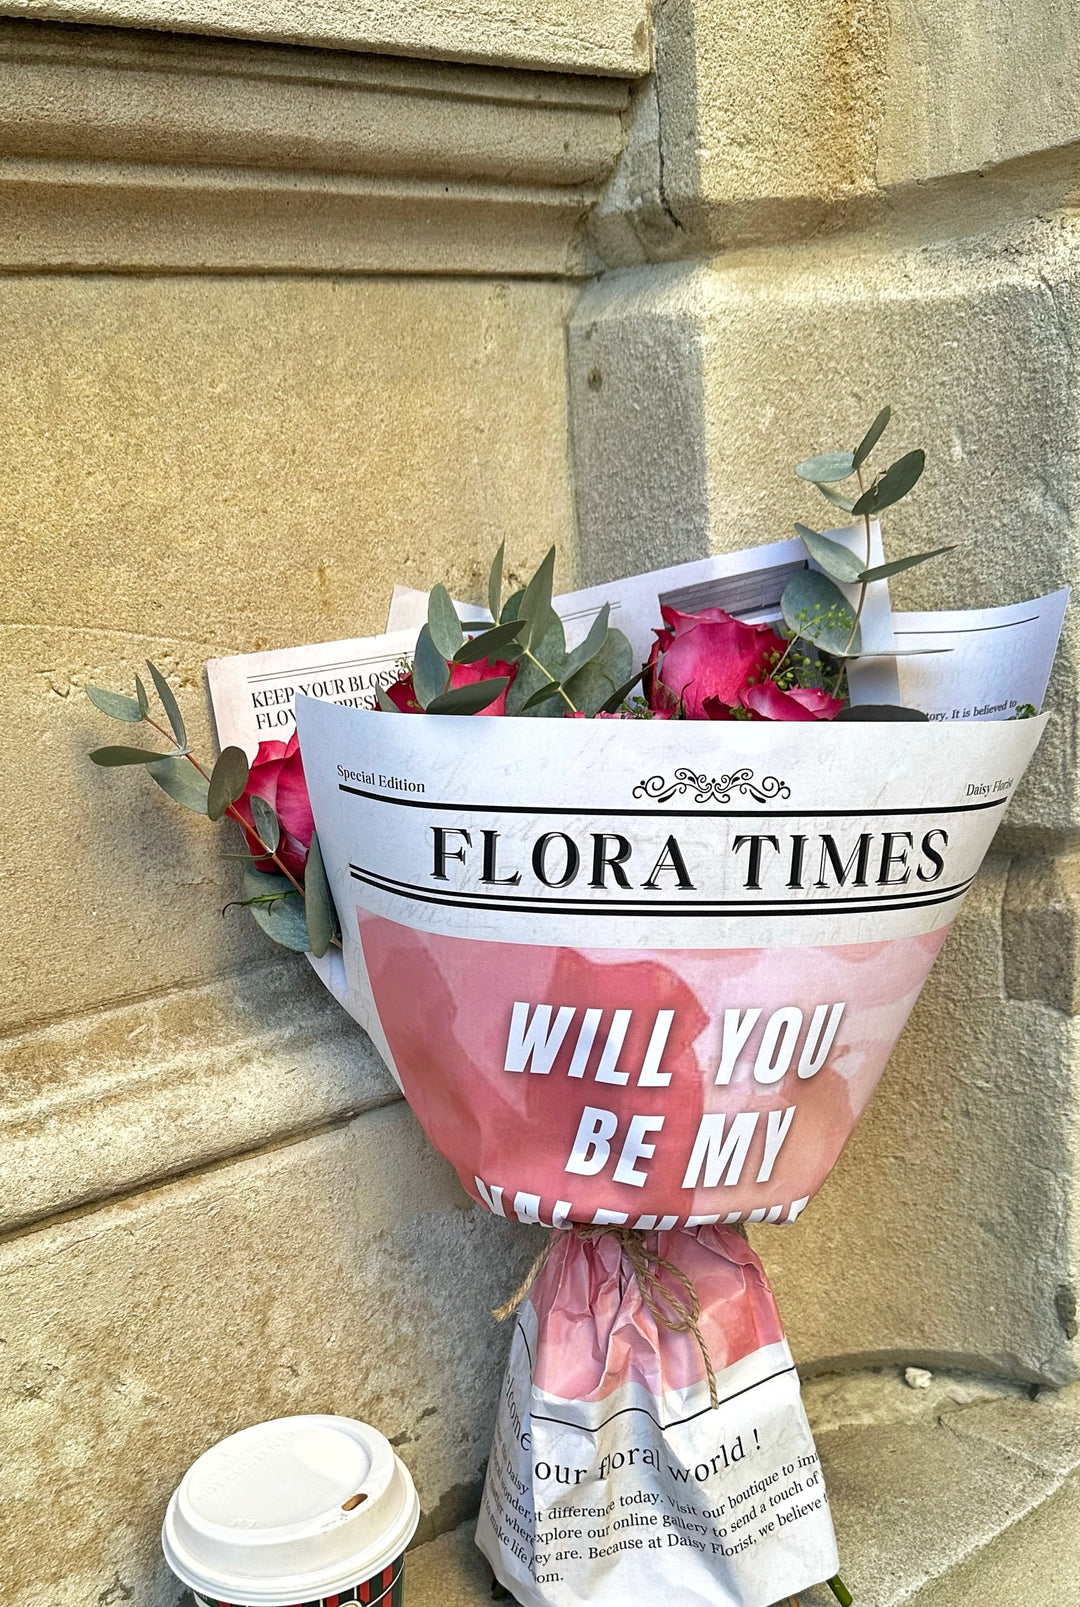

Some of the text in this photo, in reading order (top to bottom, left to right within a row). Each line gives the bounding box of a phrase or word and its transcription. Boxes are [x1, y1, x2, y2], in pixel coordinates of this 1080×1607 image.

[251, 687, 294, 708] KEEP
[298, 677, 346, 699] YOUR
[926, 699, 1018, 722] tory. It is believed to
[337, 764, 426, 793] Special Edition
[966, 783, 990, 797] Daisy
[429, 826, 949, 891] FLORA TIMES
[504, 1001, 846, 1087] WILL YOU
[564, 1105, 796, 1189] BE MY
[506, 1461, 530, 1496] Daisy
[534, 1461, 587, 1485] our
[598, 1447, 661, 1480] floral
[667, 1435, 746, 1484] world
[501, 1478, 533, 1523] wonder,
[548, 1500, 615, 1520] difference
[619, 1490, 663, 1507] today.
[666, 1494, 698, 1516] Visit
[702, 1504, 725, 1518] our
[727, 1472, 780, 1509] boutique
[782, 1463, 795, 1476] to
[587, 1525, 610, 1539] our
[613, 1512, 658, 1531] online
[662, 1514, 708, 1536] gallery
[712, 1527, 727, 1538] to
[731, 1511, 758, 1533] send
[760, 1503, 767, 1514] a
[769, 1480, 804, 1507] touch
[806, 1470, 820, 1488] of
[490, 1513, 510, 1546] make
[510, 1538, 528, 1563] life
[534, 1553, 551, 1566] ey
[555, 1549, 582, 1561] are.
[589, 1538, 643, 1559] Because
[648, 1536, 663, 1549] at
[667, 1533, 706, 1552] Daisy
[710, 1534, 757, 1557] Florist,
[758, 1520, 776, 1537] we
[777, 1498, 822, 1527] believe
